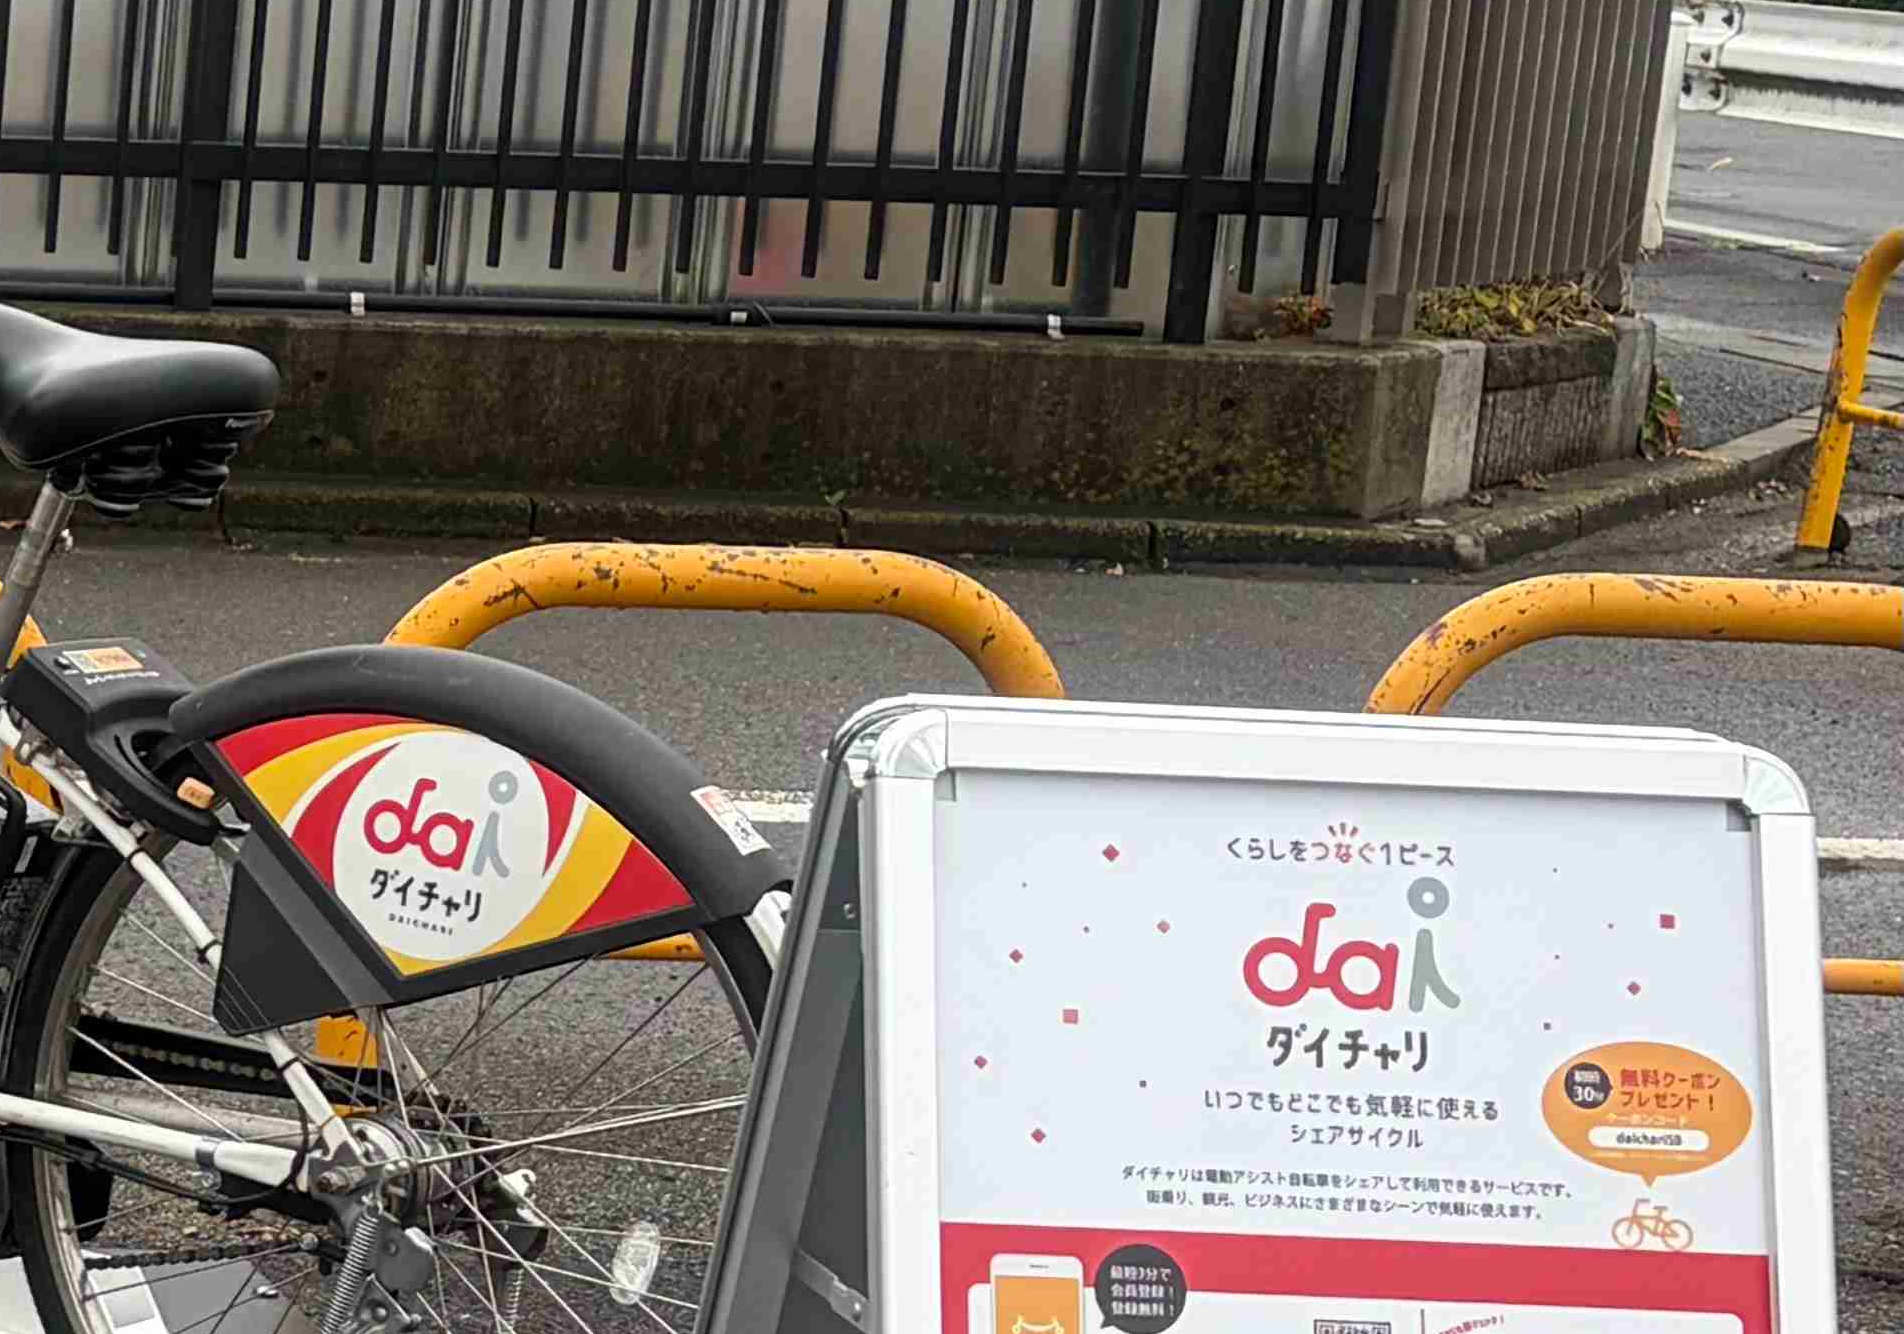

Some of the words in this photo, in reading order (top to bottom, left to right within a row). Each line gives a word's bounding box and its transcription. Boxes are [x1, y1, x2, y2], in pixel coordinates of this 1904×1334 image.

[363, 770, 519, 878] dai
[369, 868, 482, 922] ダイチャリ
[1243, 877, 1461, 1012] dai
[1267, 1023, 1429, 1072] ダイチャリ
[1620, 1069, 1721, 1089] 無料クーポン
[1205, 1090, 1498, 1121] いつでもどこでも気軽に使える
[1291, 1124, 1424, 1148] シェアサイクル
